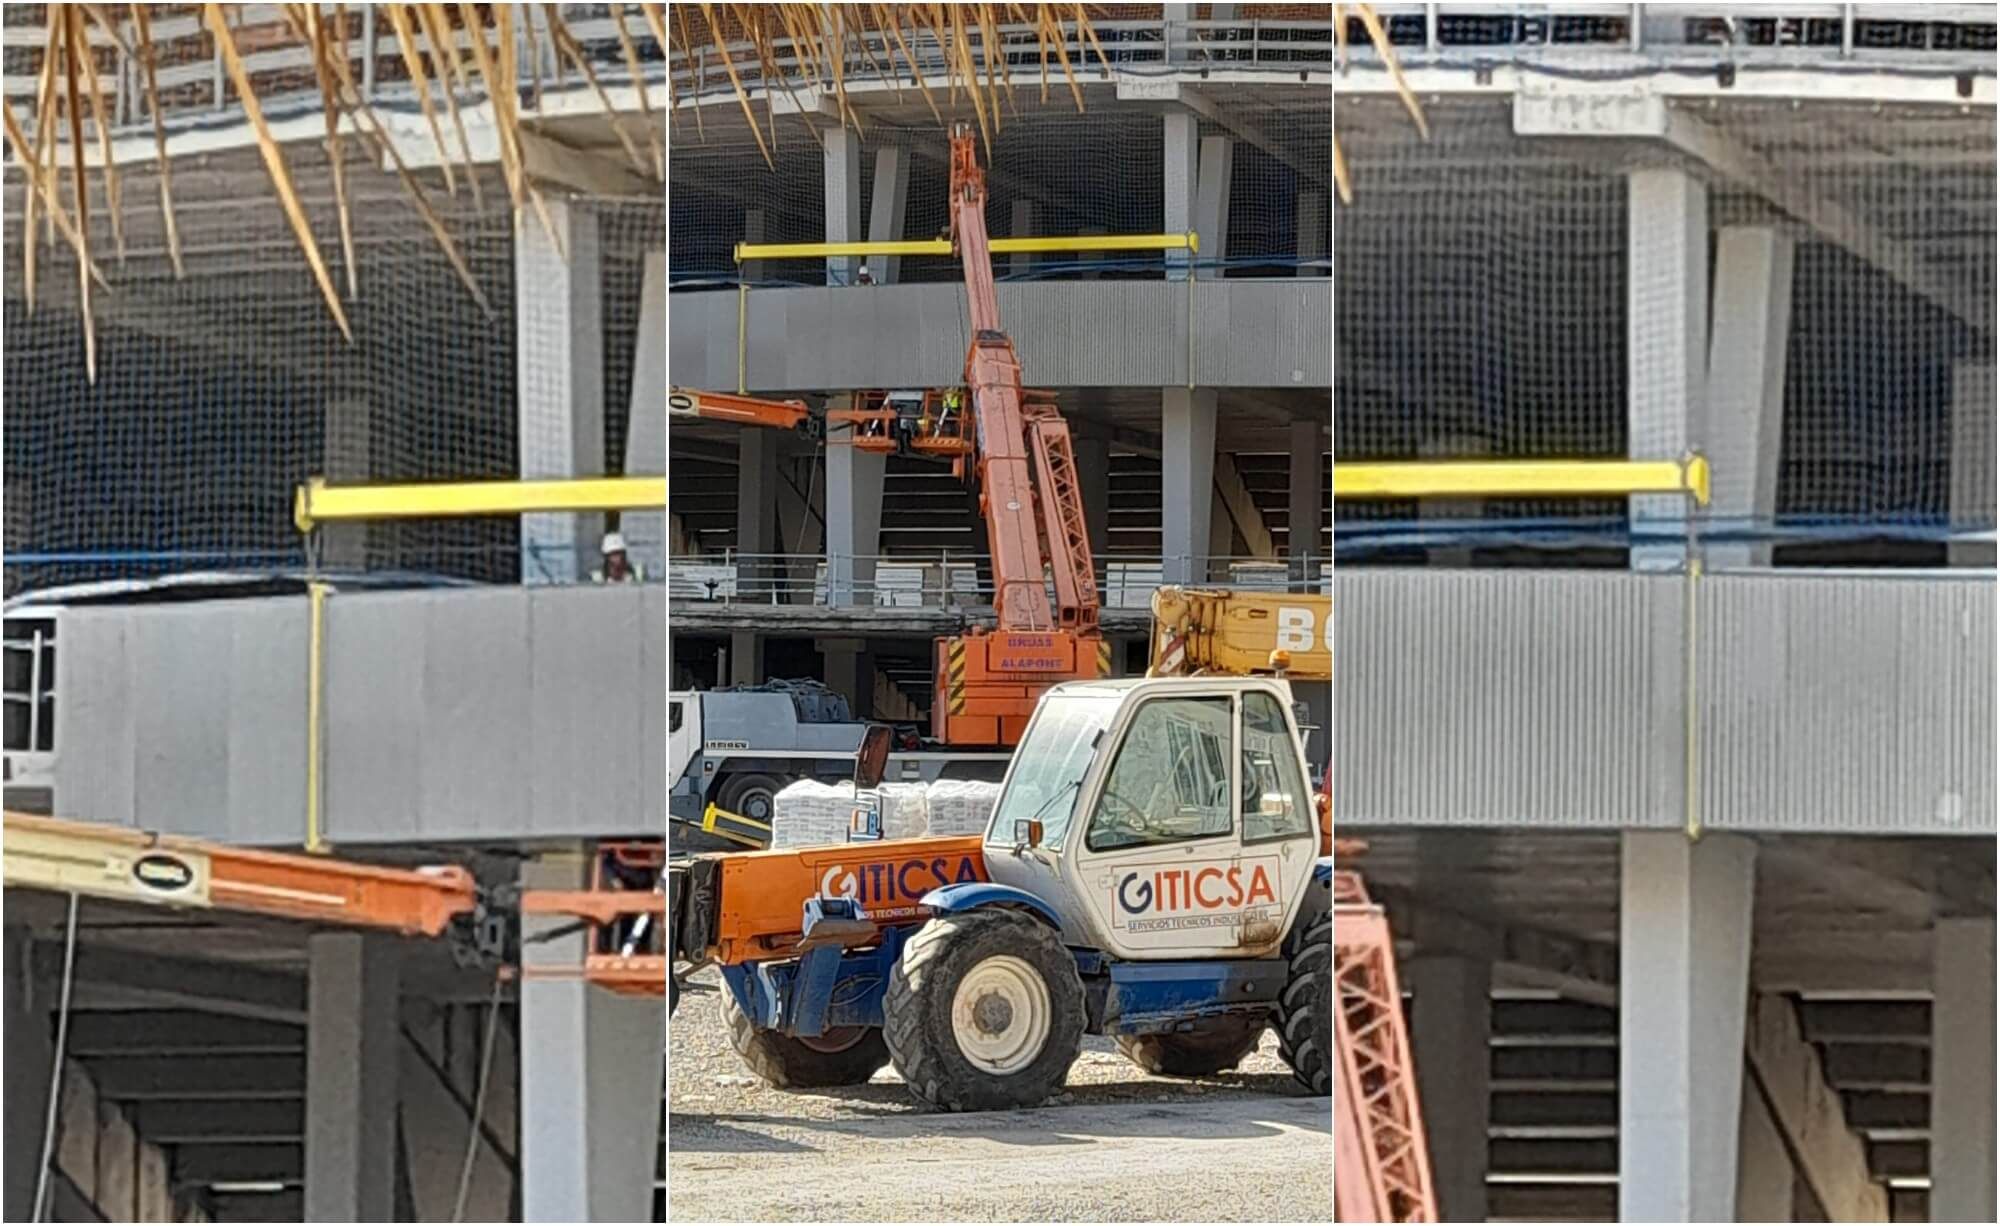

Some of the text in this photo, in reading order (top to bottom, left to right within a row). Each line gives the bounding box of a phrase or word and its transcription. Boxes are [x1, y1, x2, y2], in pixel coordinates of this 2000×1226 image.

[1276, 607, 1333, 653] B
[820, 856, 978, 903] GITICSA
[1118, 864, 1276, 915] GITICSA
